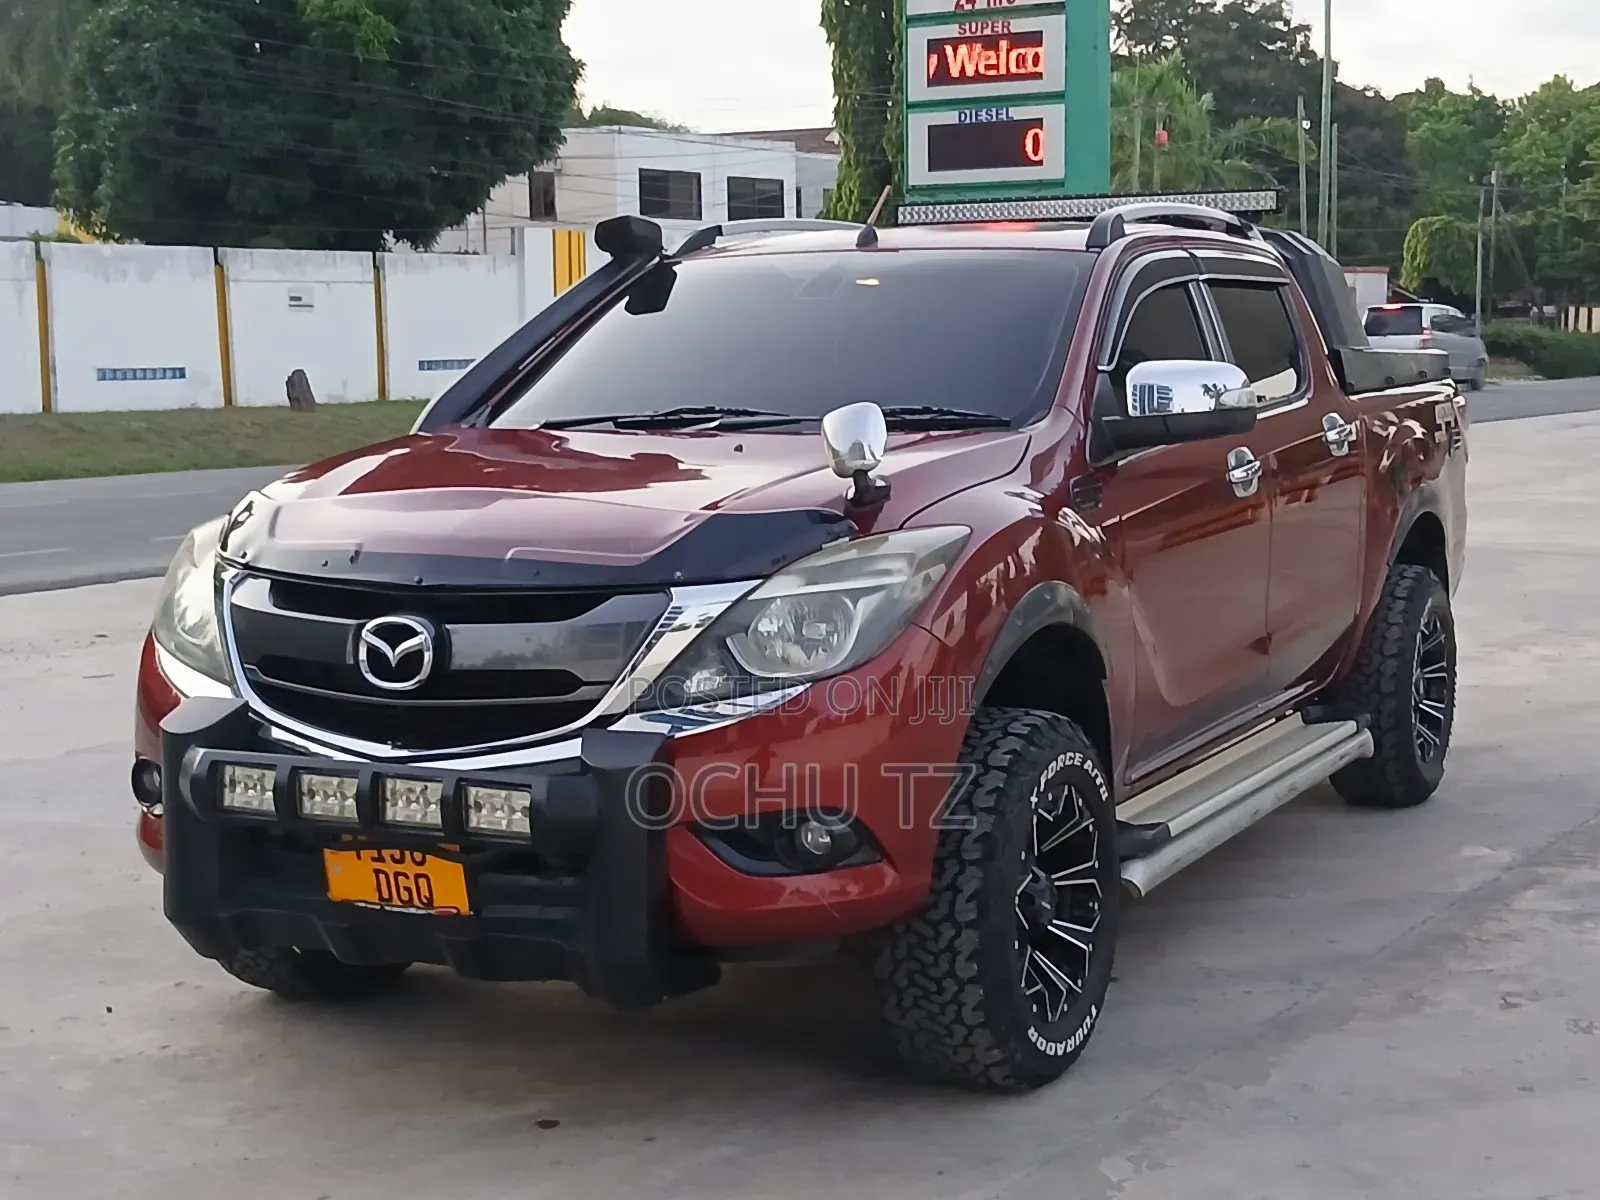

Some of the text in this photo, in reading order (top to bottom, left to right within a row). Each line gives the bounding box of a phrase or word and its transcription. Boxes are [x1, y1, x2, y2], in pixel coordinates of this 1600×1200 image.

[957, 20, 1012, 36] SUPER
[958, 107, 1014, 123] DIESEL
[1040, 752, 1084, 792] FORCE
[373, 868, 435, 908] DGQ
